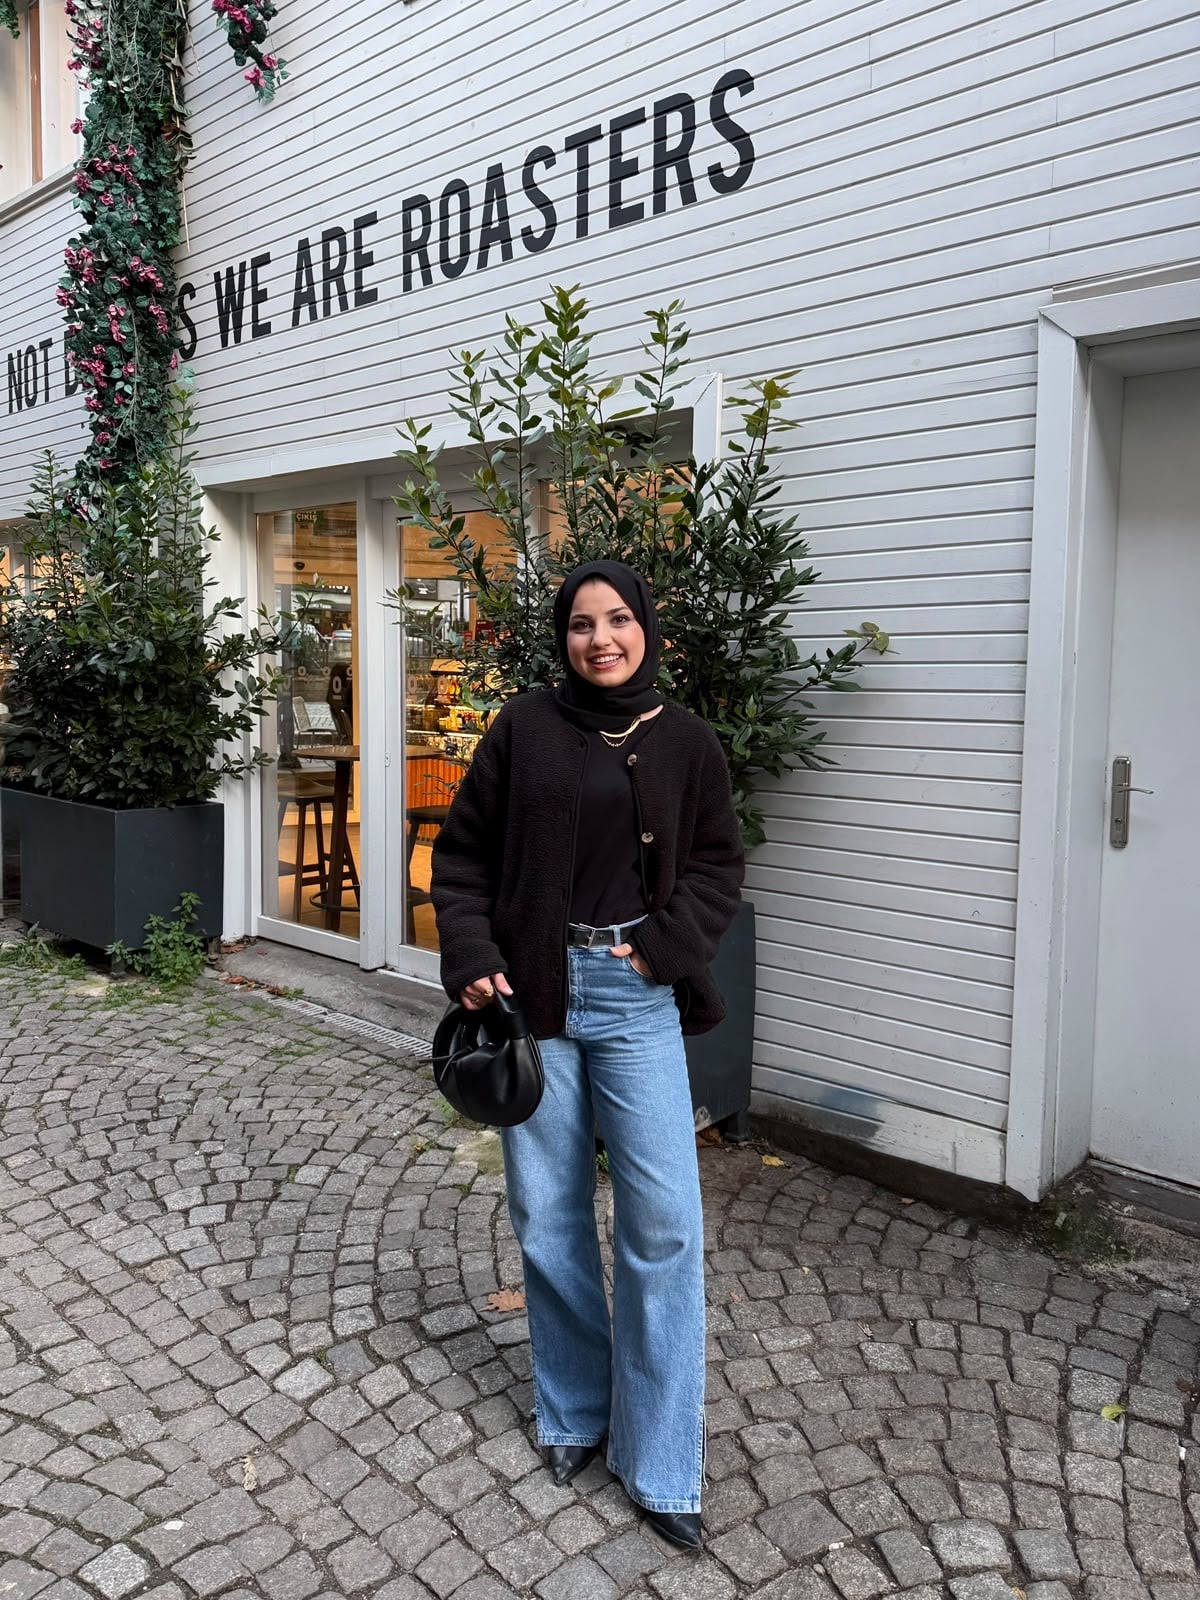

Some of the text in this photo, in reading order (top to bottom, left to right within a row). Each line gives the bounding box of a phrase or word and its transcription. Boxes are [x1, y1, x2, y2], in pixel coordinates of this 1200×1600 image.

[7, 339, 53, 414] NOT
[214, 252, 272, 348] WE
[291, 211, 378, 328] ARE
[402, 68, 755, 293] ROASTERS
